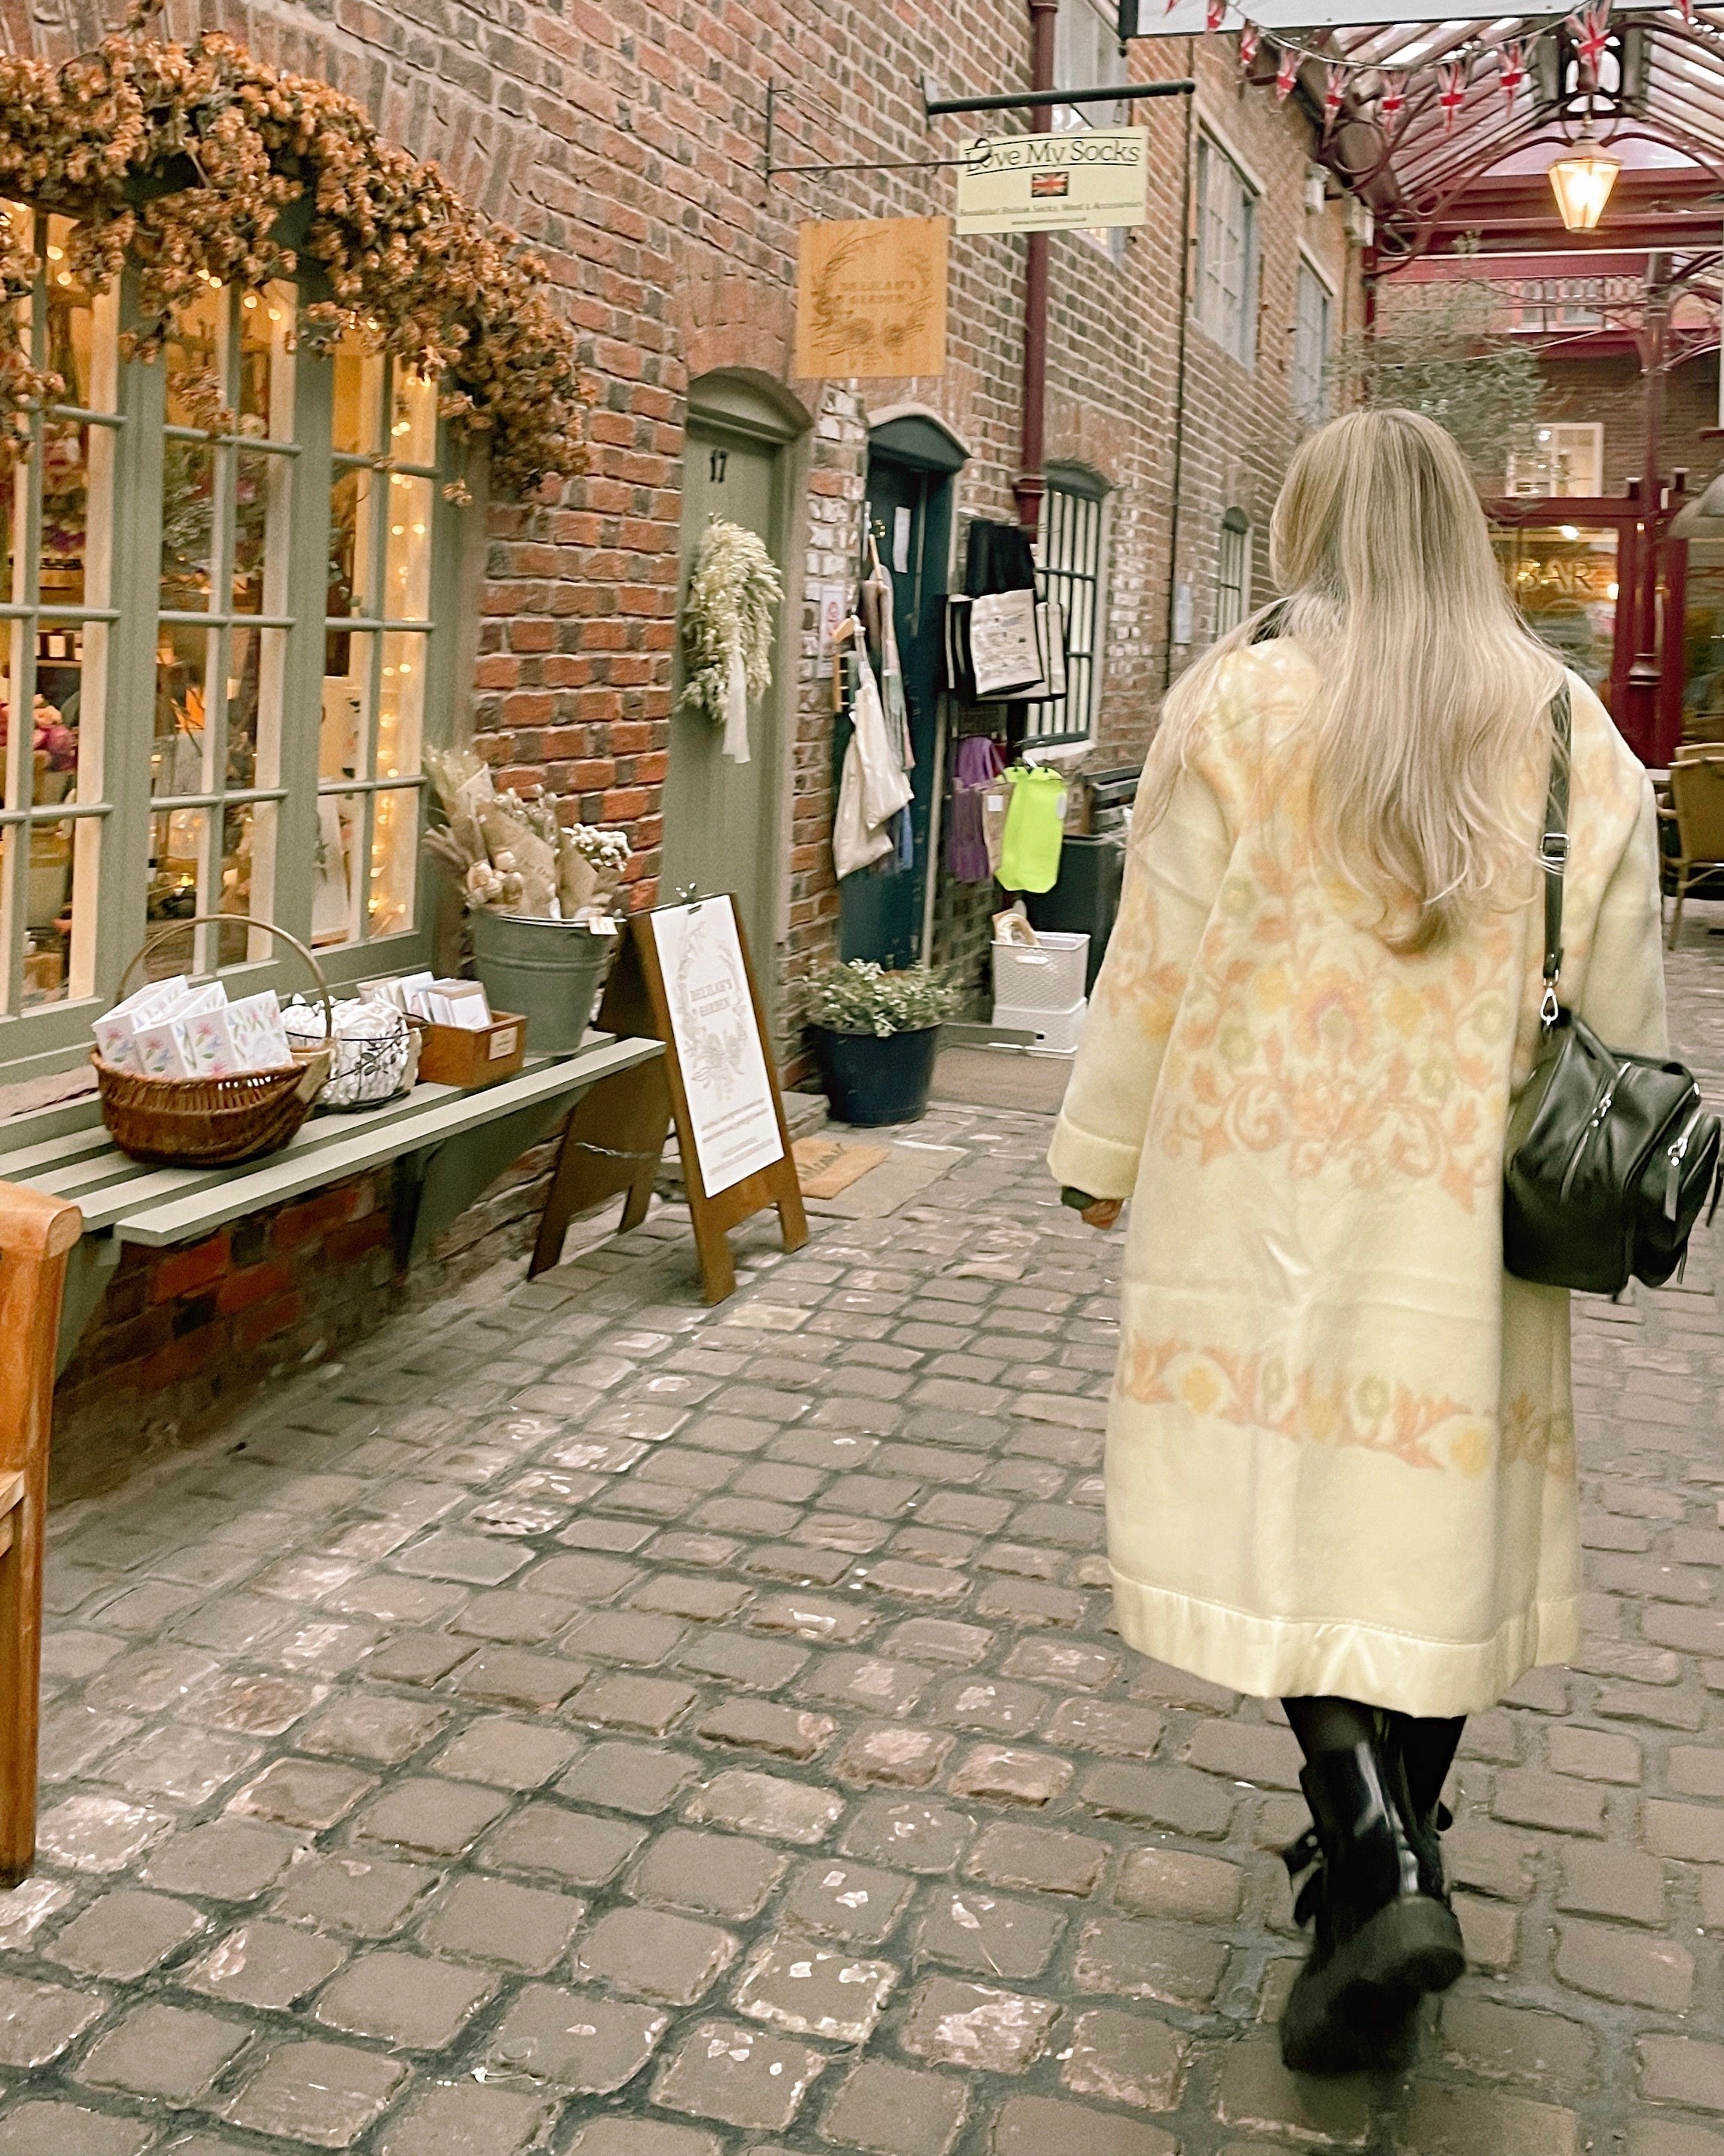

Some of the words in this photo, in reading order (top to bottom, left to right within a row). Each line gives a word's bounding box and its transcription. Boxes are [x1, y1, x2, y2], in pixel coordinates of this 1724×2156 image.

[1027, 142, 1066, 166] My
[1071, 139, 1141, 162] Socks
[710, 449, 728, 483] 17
[1518, 558, 1595, 593] BAR
